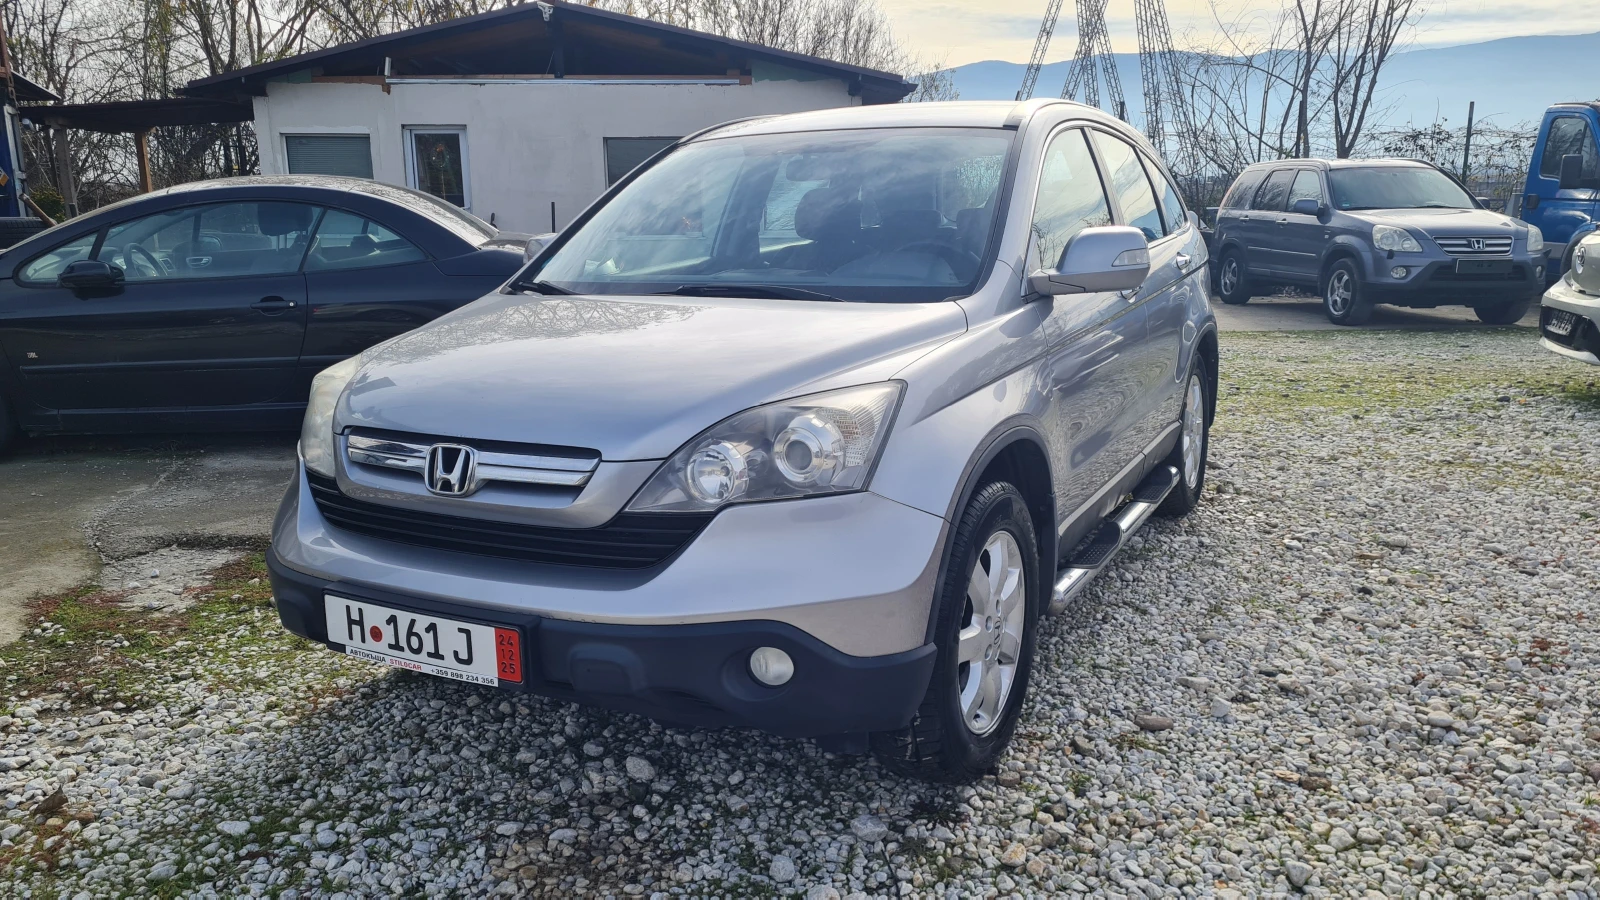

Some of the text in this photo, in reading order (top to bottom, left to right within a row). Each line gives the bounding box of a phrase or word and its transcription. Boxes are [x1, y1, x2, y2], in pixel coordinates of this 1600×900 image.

[345, 604, 473, 666] H 161 J
[499, 634, 514, 646] 24
[501, 648, 515, 661] 12
[389, 658, 422, 671] STILOCAR
[431, 669, 449, 677] +359
[450, 671, 464, 680] 898
[465, 674, 479, 682] 234
[481, 677, 495, 685] 356
[501, 661, 516, 674] 25
